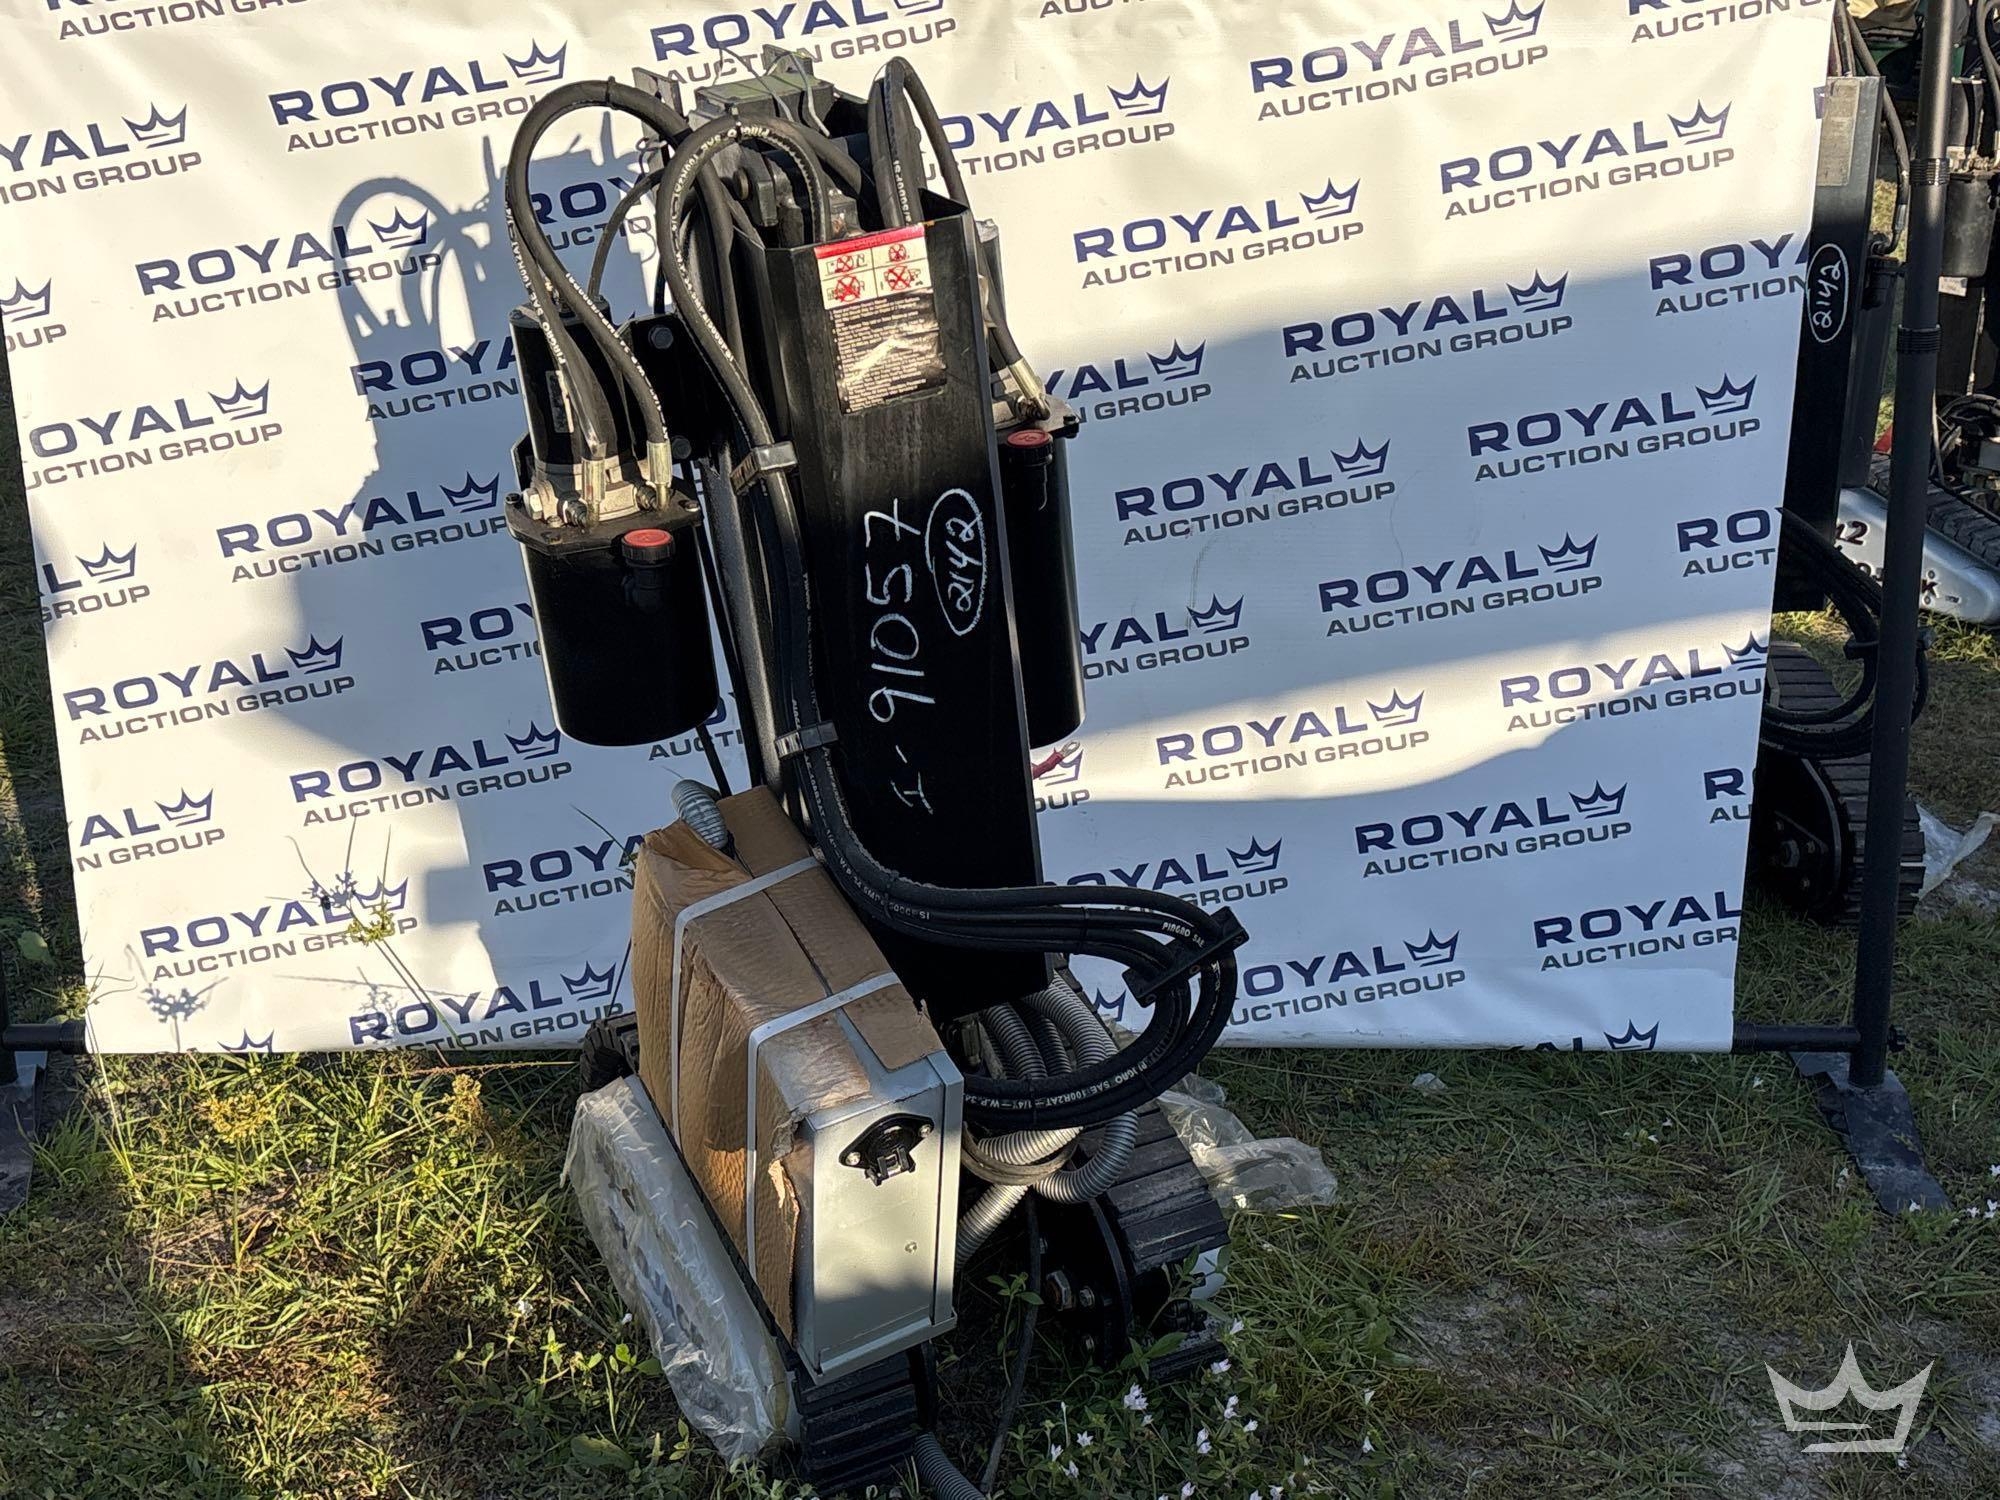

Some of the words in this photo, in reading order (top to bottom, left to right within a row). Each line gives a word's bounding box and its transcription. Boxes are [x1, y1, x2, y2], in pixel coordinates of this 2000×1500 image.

[60, 0, 225, 40] AUCTION
[650, 0, 888, 61] ROYAL
[831, 18, 955, 59] GROUP
[1632, 0, 1790, 43] AUCTION
[1250, 20, 1483, 93] ROYAL
[1258, 74, 1416, 121] AUCTION
[1426, 45, 1547, 87] GROUP
[269, 60, 508, 125] ROYAL
[288, 112, 444, 152] AUCTION
[452, 97, 535, 126] GRO
[1053, 123, 1174, 158] GROUP
[73, 152, 201, 189] GROUP
[1440, 121, 1668, 194] ROYAL
[1446, 172, 1599, 220] AUCTION
[1609, 149, 1734, 185] GROUP
[135, 226, 372, 296] ROYAL
[1074, 200, 1299, 263] ROYAL
[1083, 248, 1234, 289] AUCTION
[1243, 222, 1363, 260] GROUP
[153, 277, 310, 322] AUCTION
[317, 254, 441, 289] GROUP
[1812, 259, 1842, 329] 2142
[1283, 290, 1508, 357] ROYAL
[1290, 339, 1442, 383] AUCTION
[1450, 316, 1572, 352] GROUP
[1094, 384, 1211, 420] GROUP
[1468, 392, 1696, 456] ROYAL
[159, 423, 282, 460] GROUP
[1475, 440, 1628, 482] AUCTION
[1637, 419, 1760, 453] GROUP
[1115, 457, 1332, 521] ROYAL
[1124, 504, 1270, 546] AUCTION
[1278, 482, 1395, 517] GROUP
[216, 491, 445, 558] ROYAL
[232, 540, 384, 583] AUCTION
[391, 516, 507, 551] GROUP
[945, 513, 983, 612] 2142
[1319, 550, 1539, 612] ROYAL
[1327, 597, 1474, 637] AUCTION
[1483, 576, 1602, 609] GROUP
[1136, 636, 1249, 670] GROUP
[1501, 649, 1722, 707] ROYAL
[63, 654, 290, 721] ROYAL
[80, 700, 230, 744] AUCTION
[236, 676, 355, 712] GROUP
[1508, 694, 1657, 732] AUCTION
[1156, 707, 1368, 765] ROYAL
[1165, 751, 1307, 788] AUCTION
[1315, 731, 1428, 762] GROUP
[290, 740, 509, 802] ROYAL
[304, 785, 450, 826] AUCTION
[456, 762, 572, 797] GROUP
[108, 828, 225, 866] GROUP
[1355, 797, 1570, 854] ROYAL
[1363, 841, 1508, 878] AUCTION
[1516, 822, 1631, 853] GROUP
[1534, 896, 1742, 948] ROYAL
[1541, 934, 1685, 971] AUCTION
[152, 940, 298, 982] AUCTION
[1354, 970, 1465, 1003] GROUP
[349, 979, 563, 1045] ROYAL
